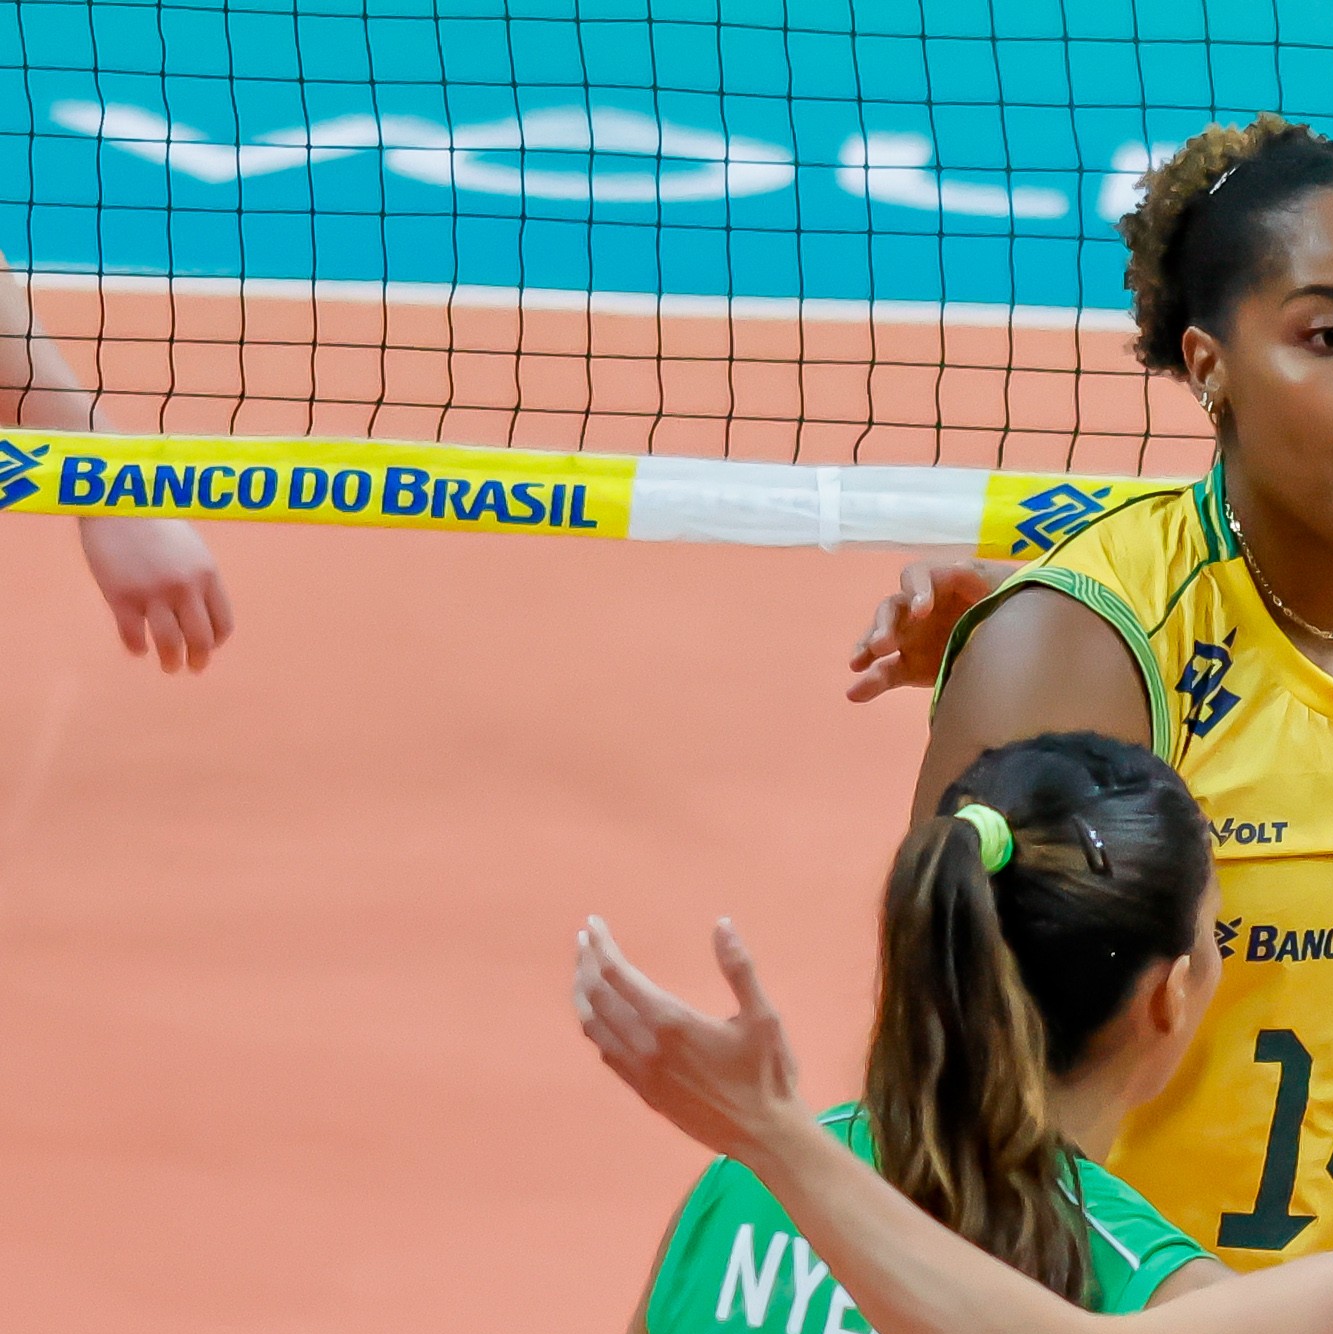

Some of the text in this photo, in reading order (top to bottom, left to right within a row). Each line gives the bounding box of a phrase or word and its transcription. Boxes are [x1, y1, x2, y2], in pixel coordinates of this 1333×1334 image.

[59, 455, 598, 529] BANCO DO BRASIL
